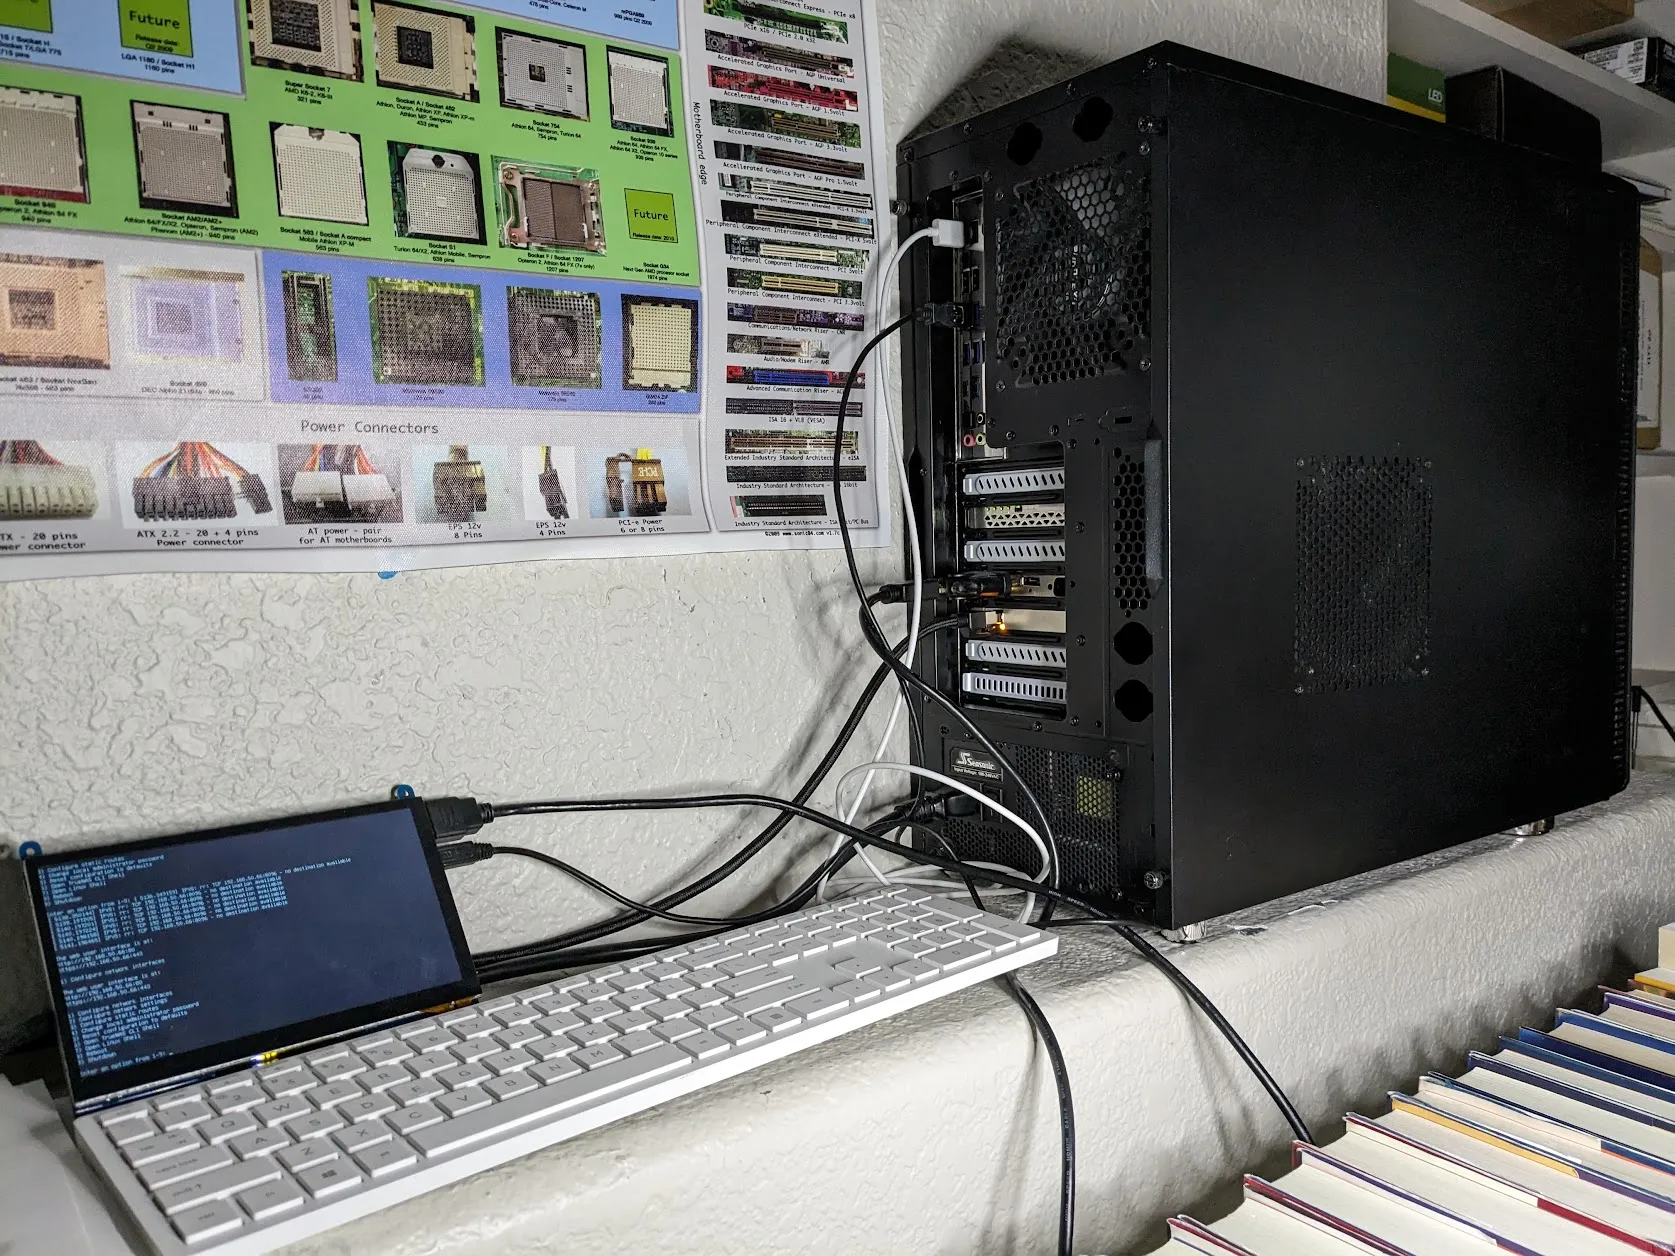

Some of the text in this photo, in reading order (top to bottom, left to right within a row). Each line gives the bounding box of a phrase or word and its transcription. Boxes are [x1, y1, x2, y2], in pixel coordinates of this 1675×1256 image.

[804, 4, 825, 13] Express
[130, 10, 180, 29] Future
[744, 23, 757, 32] PCIe
[122, 53, 138, 61] LGA
[161, 59, 184, 68] Socket
[718, 54, 754, 66] Accelerated
[756, 62, 782, 72] Graphics
[818, 74, 846, 84] Universal
[305, 83, 324, 91] Socket
[1428, 88, 1442, 102] LED
[724, 90, 760, 100] Accelerated
[763, 97, 788, 107] Graphics
[824, 108, 845, 116] 1.5volt
[693, 102, 708, 185] Motherboard edge
[728, 128, 764, 138] Accelerated
[766, 134, 792, 144] Graphics
[826, 143, 848, 152] 3.3volt
[766, 167, 790, 176] Graphics
[837, 178, 858, 187] 1.5volt
[634, 209, 668, 221] Future
[706, 219, 876, 245] Peripheral Component Interconnect eXtended PCI-X 5volt
[730, 255, 761, 265] Peripheral
[764, 259, 792, 268] Component
[796, 262, 829, 272] Interconnect
[728, 288, 759, 298] Peripheral
[762, 291, 790, 300] Component
[792, 294, 826, 303] Interconnect
[748, 322, 812, 333] Communications/Network
[300, 420, 439, 434] Power Connectors
[52, 532, 78, 541] pins
[236, 528, 258, 538] pins
[364, 527, 381, 536] pair
[300, 536, 314, 544] for
[112, 1000, 136, 1008] network
[140, 990, 173, 1002] interfaces
[140, 998, 168, 1008] settings
[126, 1002, 200, 1024] administrator password
[138, 1006, 158, 1014] routes
[161, 1010, 188, 1021] defaults
[142, 1023, 160, 1032] Shell
[124, 1034, 140, 1042] Shell
